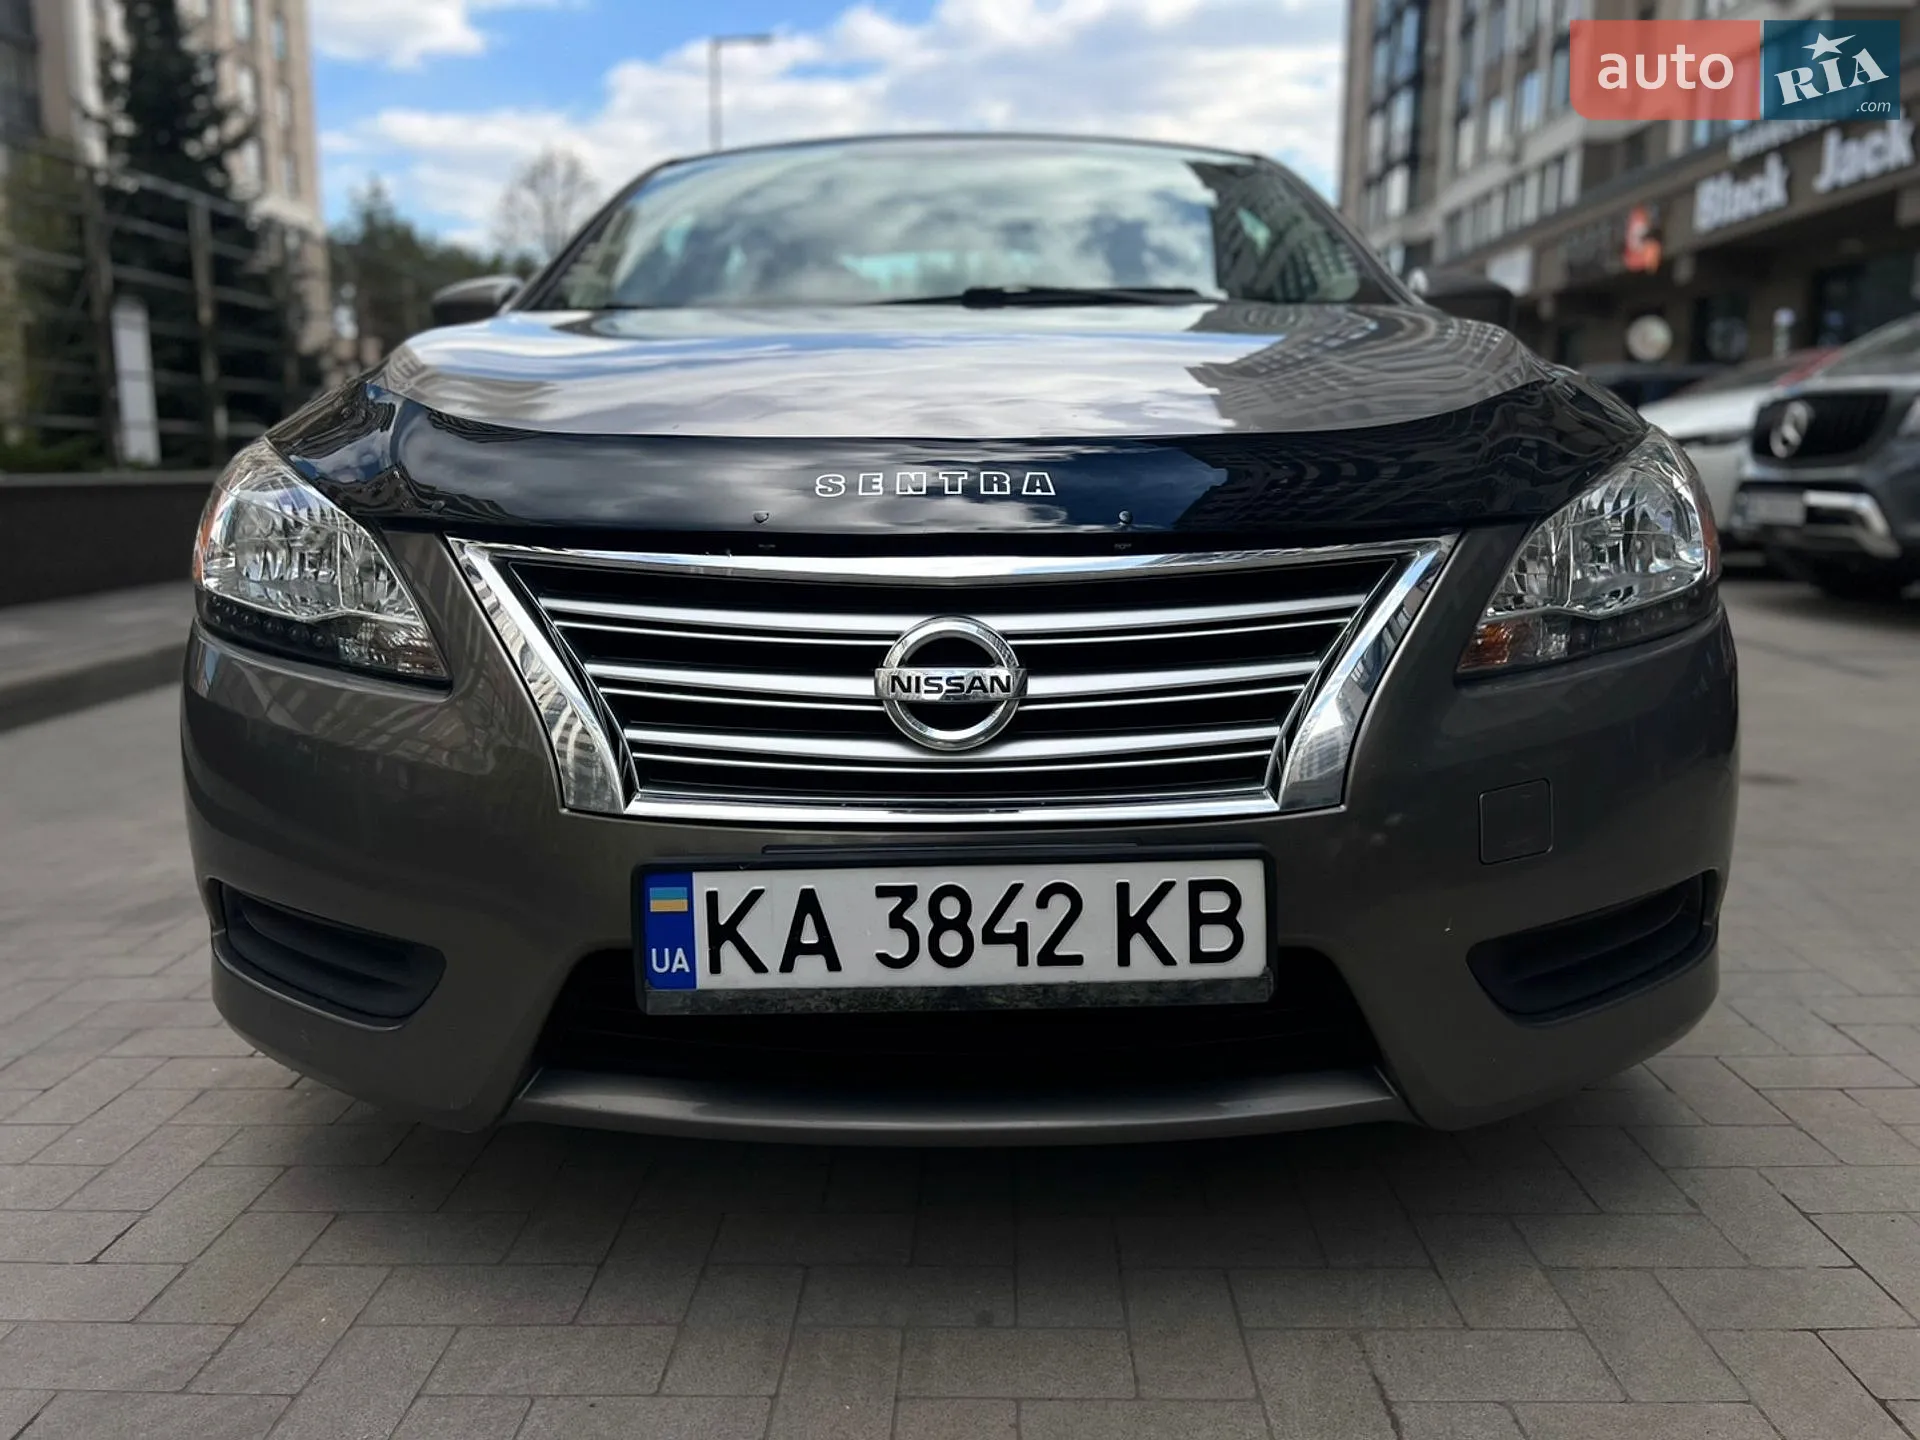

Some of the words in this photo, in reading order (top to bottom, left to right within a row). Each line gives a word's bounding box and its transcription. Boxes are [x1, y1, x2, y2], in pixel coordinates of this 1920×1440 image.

[1812, 107, 1915, 194] Jack
[815, 471, 1056, 498] SENTRA
[890, 674, 1012, 695] NISSAN
[704, 886, 843, 975] KA
[874, 880, 1085, 970] 3842
[1115, 878, 1245, 968] KB
[651, 947, 691, 974] UA
